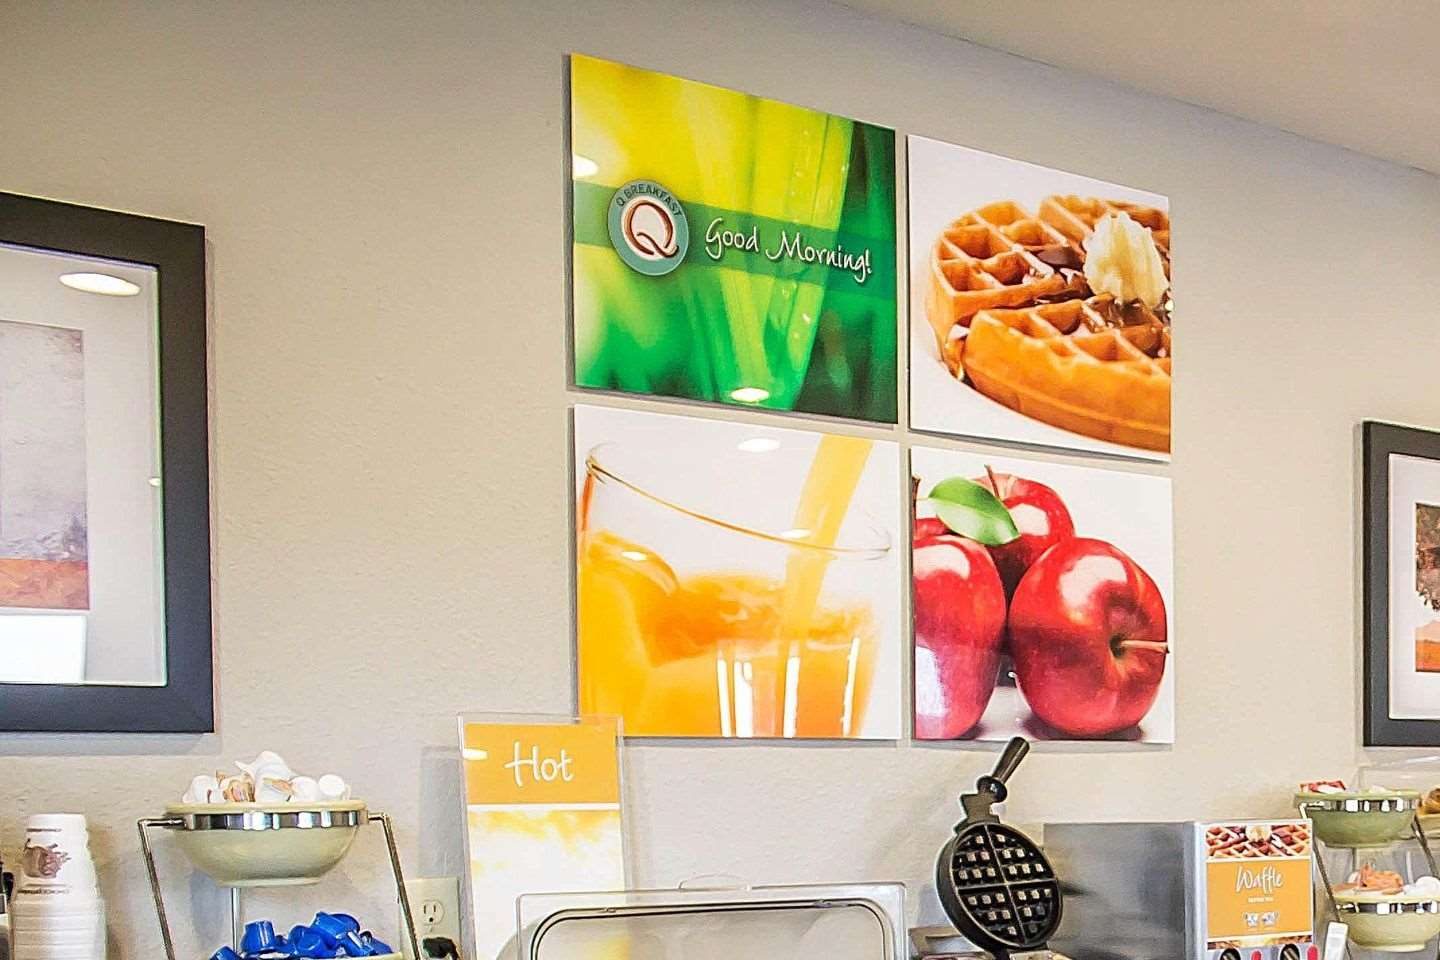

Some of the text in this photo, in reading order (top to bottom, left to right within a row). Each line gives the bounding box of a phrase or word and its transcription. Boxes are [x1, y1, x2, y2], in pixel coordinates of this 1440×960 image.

[624, 183, 682, 216] BREAKFAST
[705, 217, 872, 283] Good Morning!
[504, 741, 575, 787] Hot
[1235, 864, 1284, 894] Waffle
